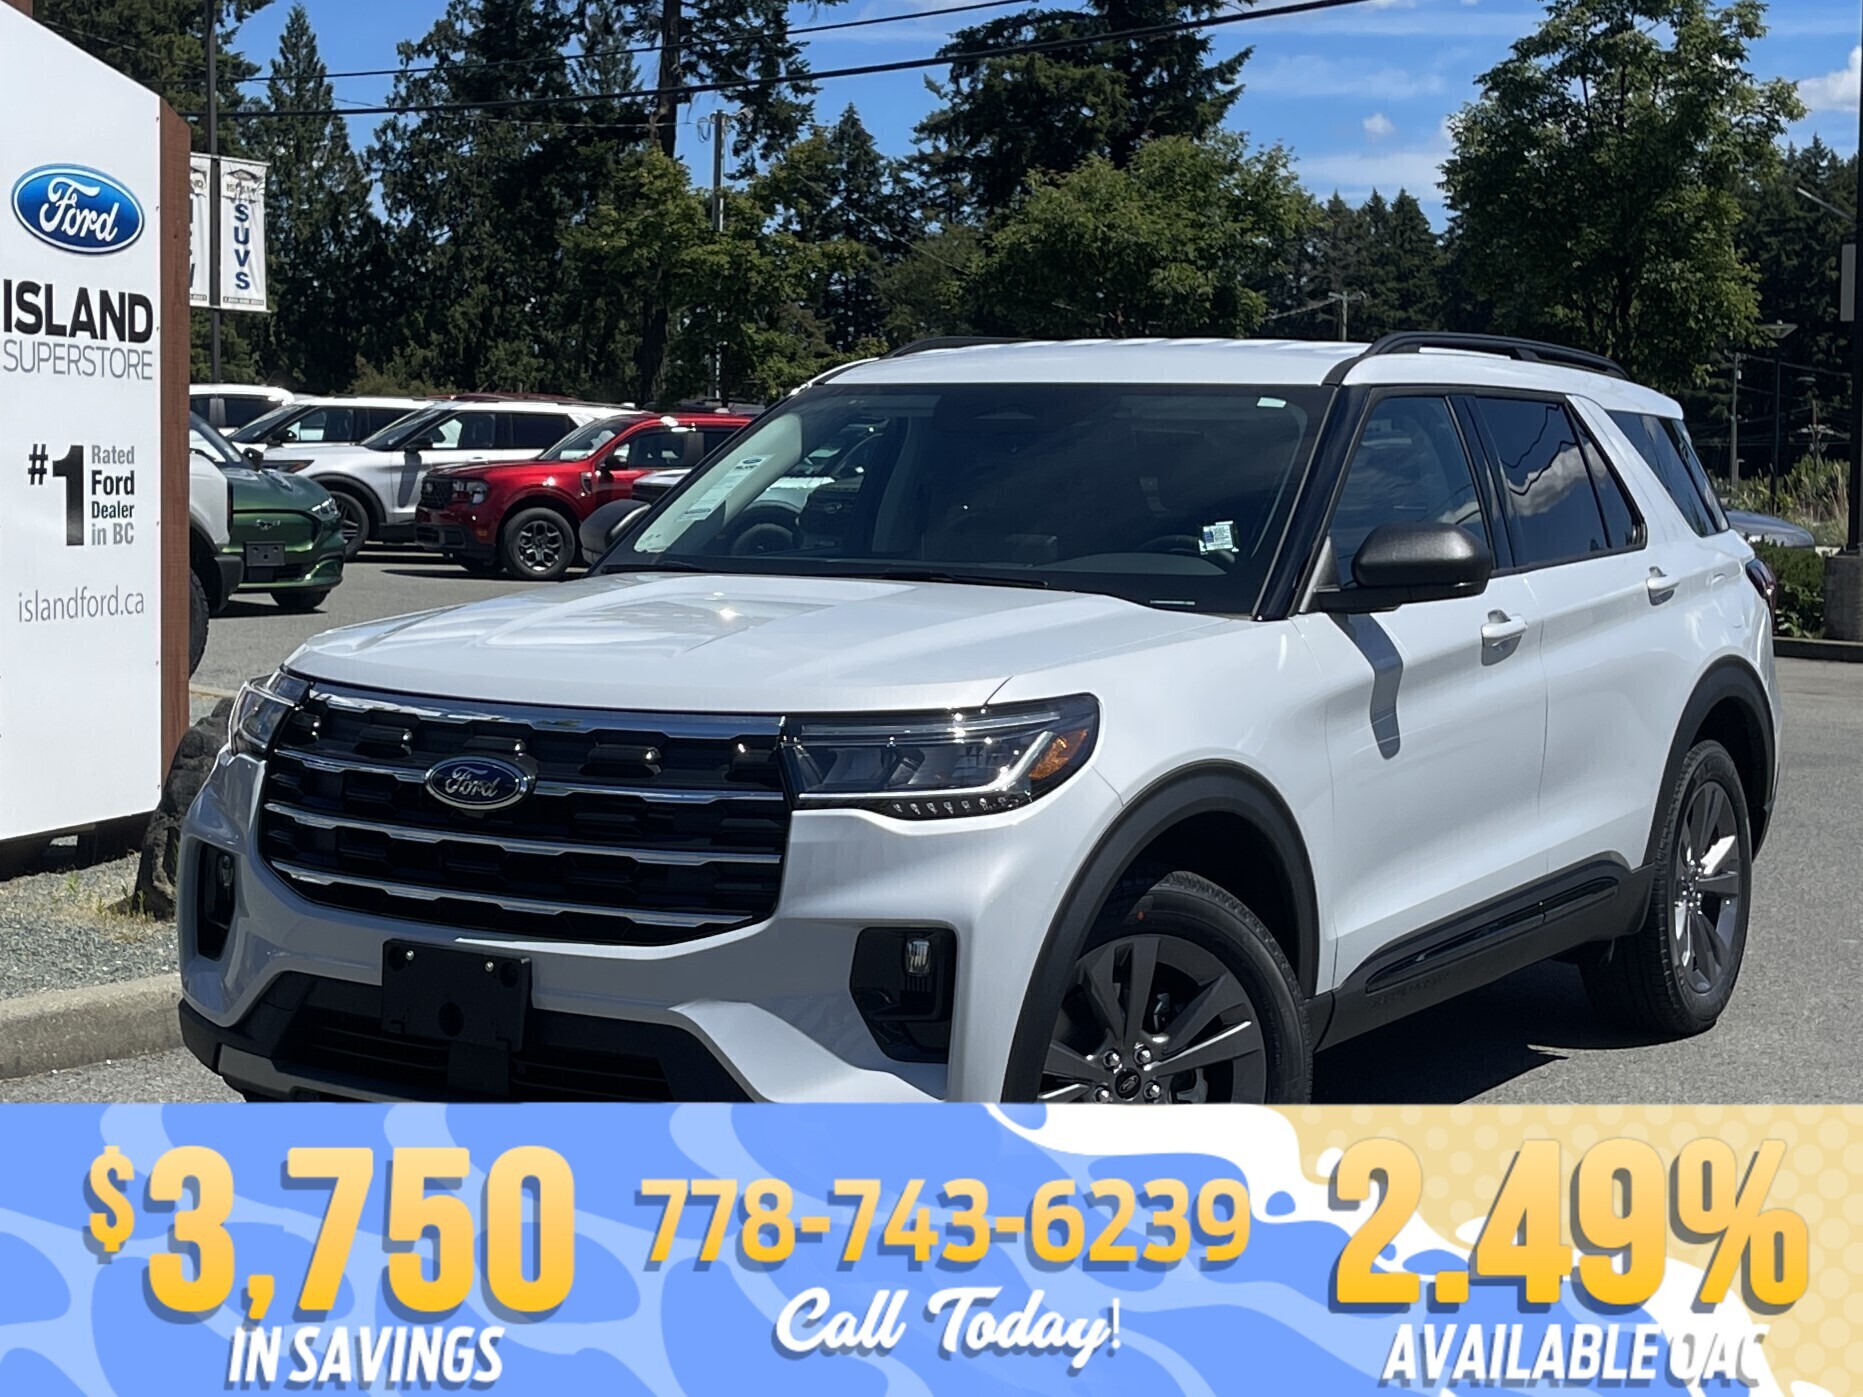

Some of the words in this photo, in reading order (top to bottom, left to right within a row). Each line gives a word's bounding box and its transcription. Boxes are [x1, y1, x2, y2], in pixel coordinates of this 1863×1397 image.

[39, 176, 120, 242] Ford
[233, 202, 252, 291] SUVS
[2, 278, 154, 344] ISLAND
[2, 338, 154, 381] SUPERSTORE
[91, 444, 136, 465] Rated
[27, 443, 85, 547] #1
[91, 469, 136, 496] Ford
[91, 500, 136, 519] Dealer
[91, 523, 107, 546] in
[113, 521, 135, 546] BC
[18, 584, 145, 623] islandford.ca
[444, 765, 501, 798] Ford
